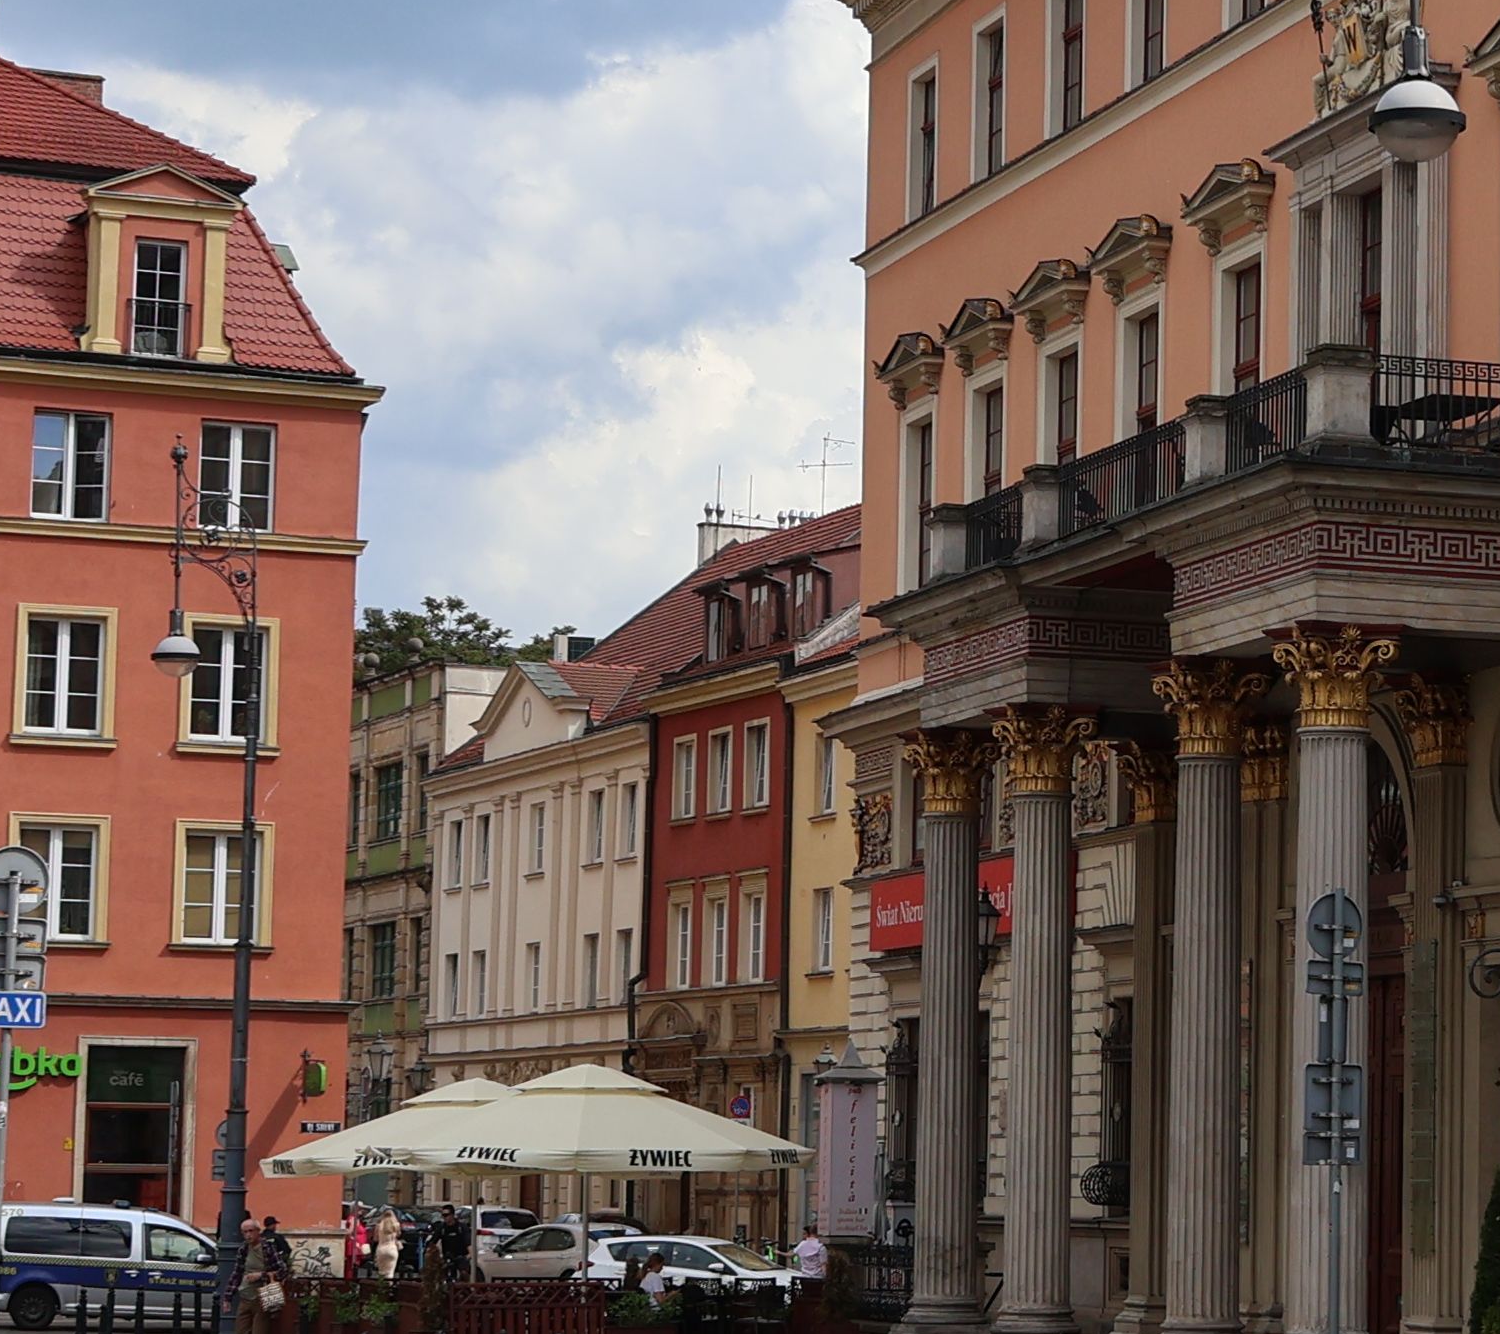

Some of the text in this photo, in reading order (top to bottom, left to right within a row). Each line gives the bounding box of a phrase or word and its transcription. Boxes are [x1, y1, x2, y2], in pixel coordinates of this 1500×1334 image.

[876, 897, 924, 928] Świat Nieru
[457, 1146, 521, 1163] ŻYWIEC
[629, 1149, 692, 1167] ŻYWIEC
[768, 1149, 800, 1164] ŻYWIEC
[273, 1160, 296, 1174] ŻYWIEC
